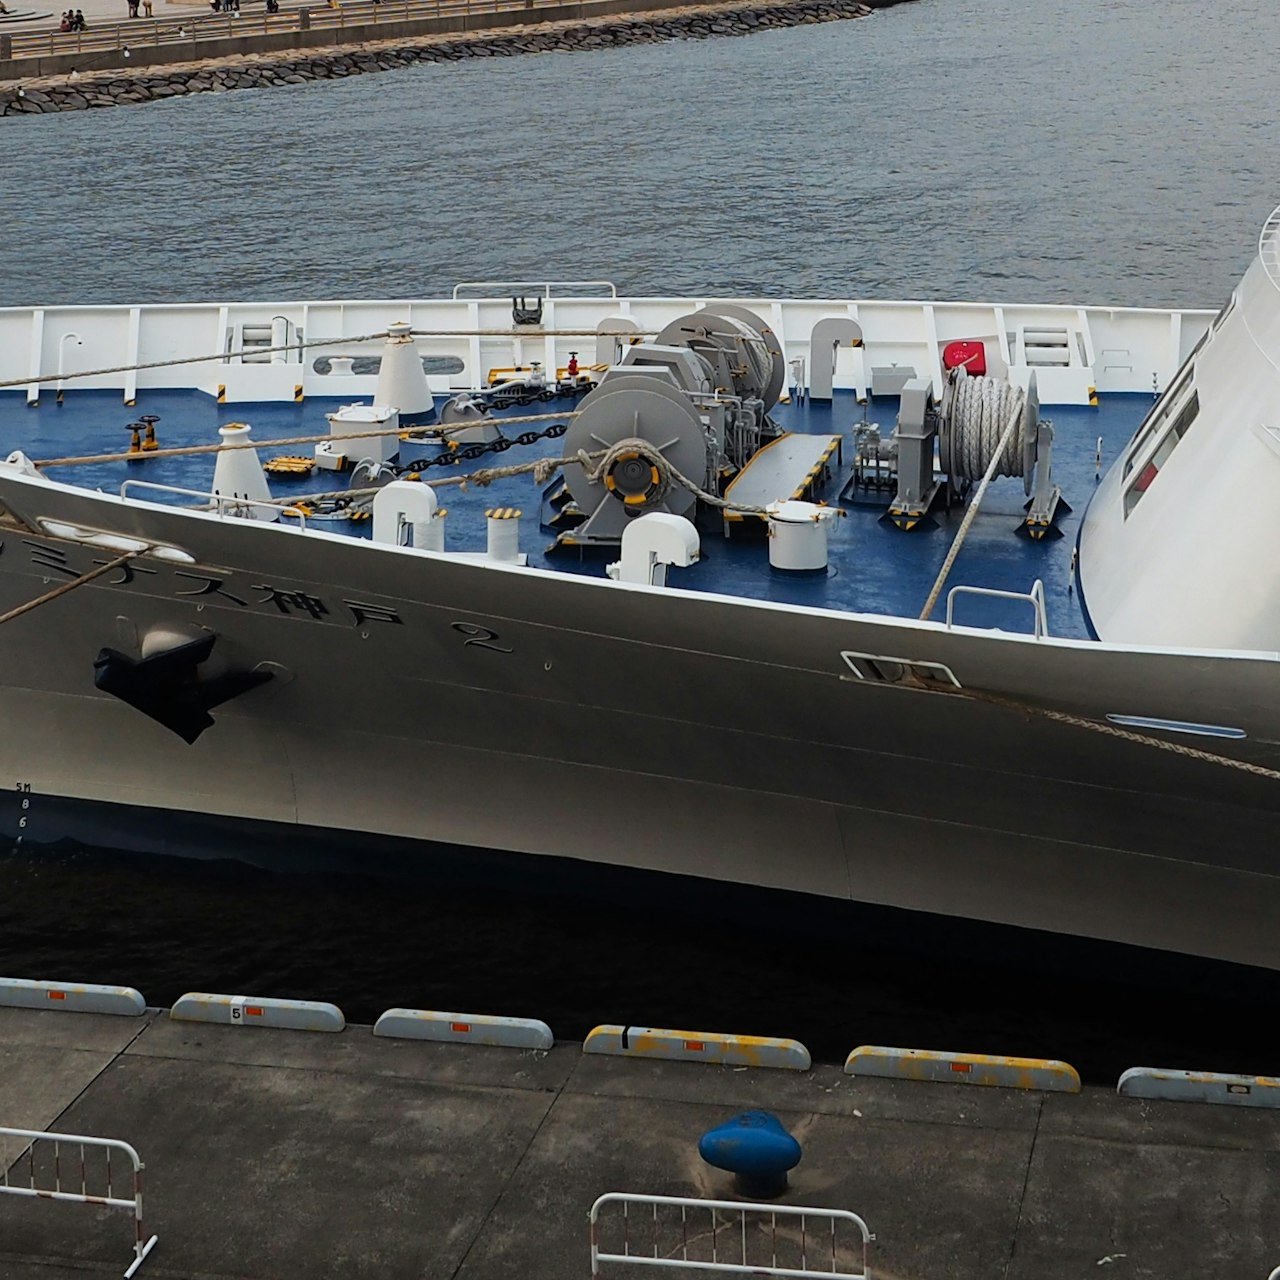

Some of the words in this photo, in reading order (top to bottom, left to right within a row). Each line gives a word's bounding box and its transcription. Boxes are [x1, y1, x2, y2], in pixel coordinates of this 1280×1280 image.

[21, 798, 30, 809] 8
[19, 816, 27, 828] 6
[232, 1008, 241, 1019] 5
